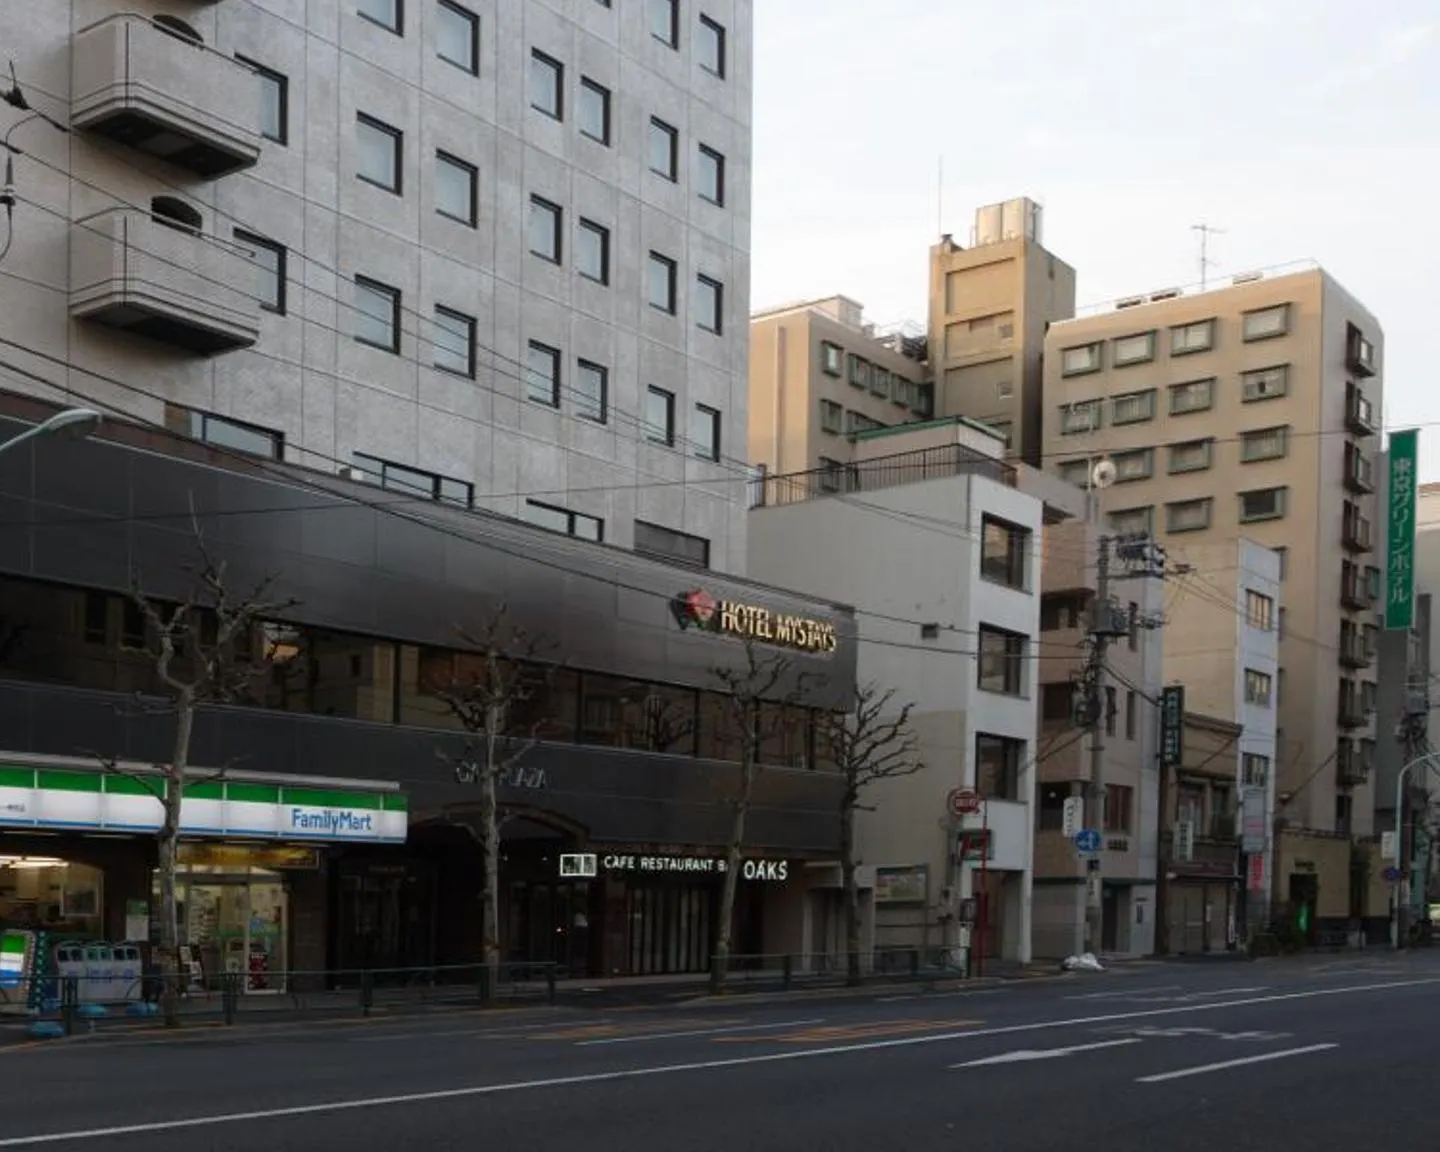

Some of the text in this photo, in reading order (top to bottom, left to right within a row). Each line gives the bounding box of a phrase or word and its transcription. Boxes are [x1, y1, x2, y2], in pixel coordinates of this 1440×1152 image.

[1391, 457, 1413, 604] 東京グリーンホテル
[721, 600, 837, 652] HOTEL MYSTAYS
[292, 808, 372, 835] FamilyMart
[603, 856, 634, 870] CAFE
[640, 856, 714, 873] RESTAURANT
[743, 858, 788, 881] OAKS
